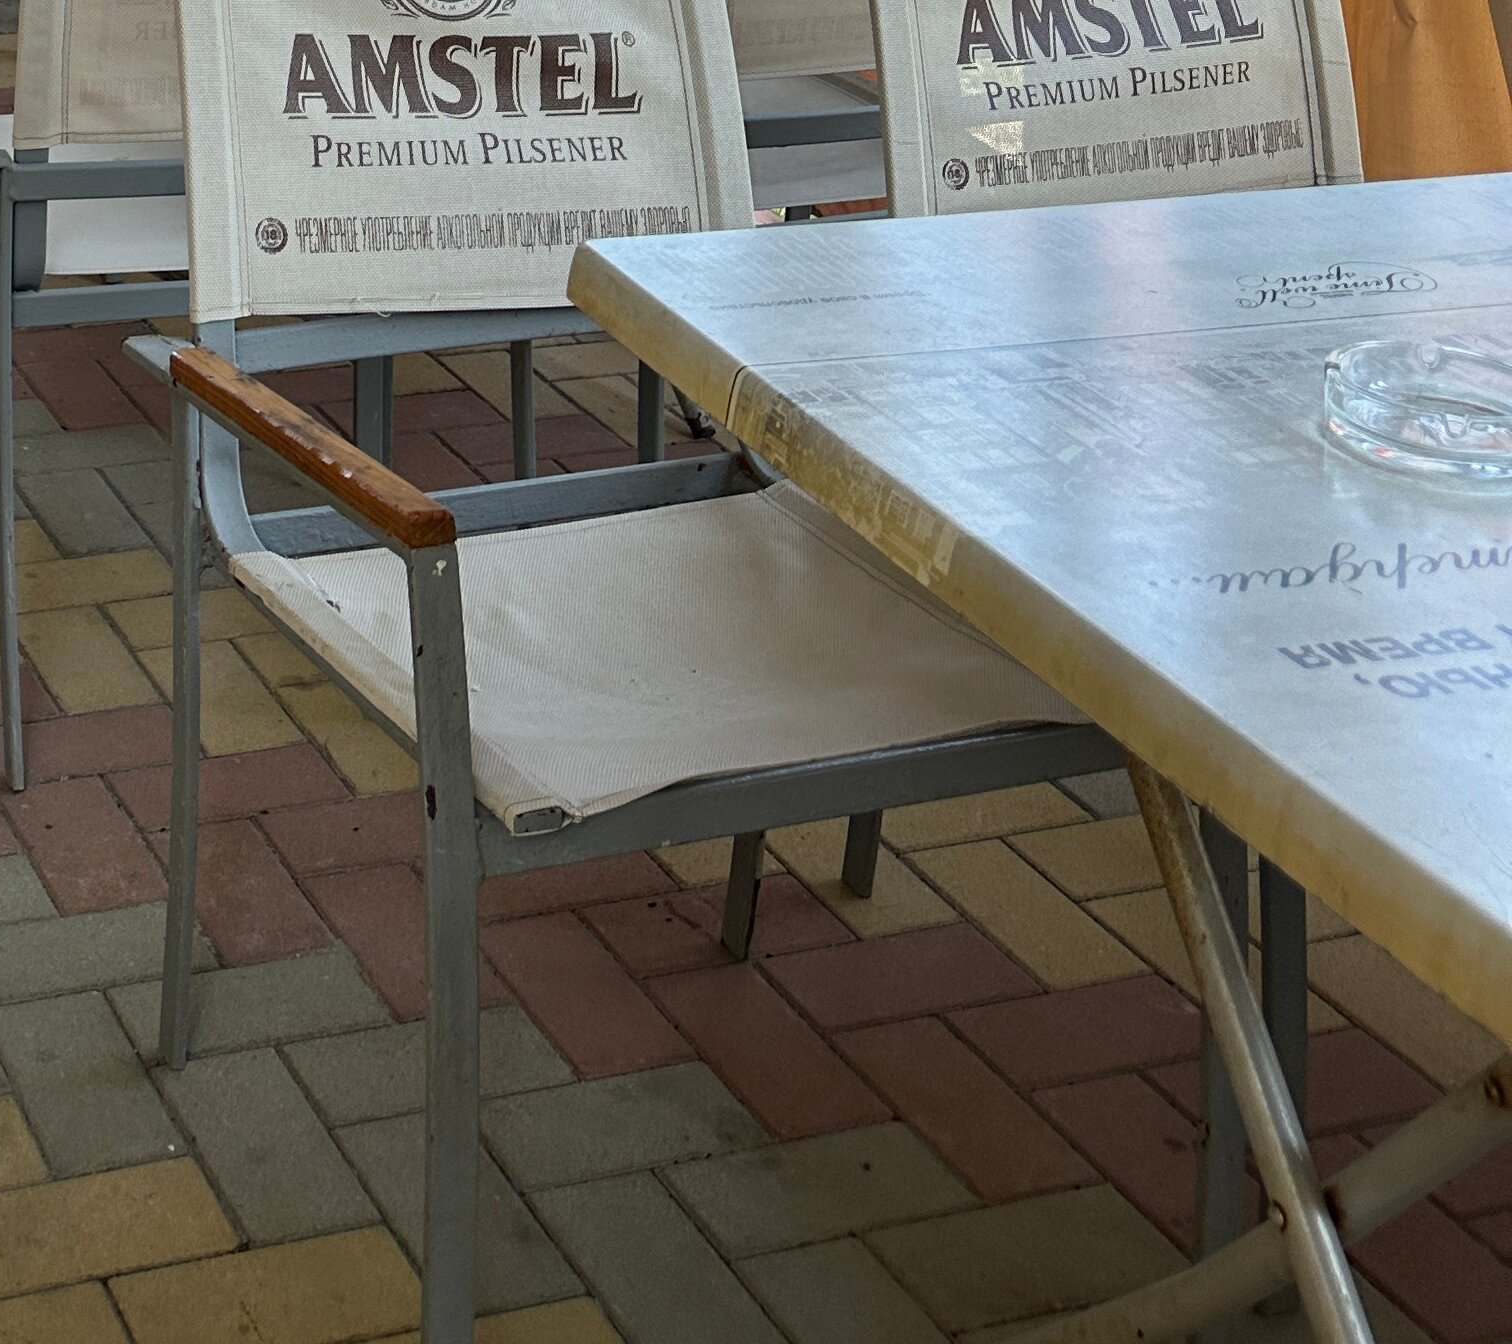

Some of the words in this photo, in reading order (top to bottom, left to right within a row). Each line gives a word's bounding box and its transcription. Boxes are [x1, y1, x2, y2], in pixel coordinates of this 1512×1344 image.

[282, 31, 643, 119] AMSTEL
[984, 76, 1120, 111] PREMIUM
[1128, 60, 1251, 97] PILSENER
[311, 134, 469, 168] PREMIUM
[478, 132, 628, 164] PILSENER
[295, 216, 360, 254] ЧРЕЗМЕРНОЕ
[360, 215, 434, 252] УПОТРЕБЛЕНИЕ
[1277, 627, 1495, 669] ВРЕМЯ
